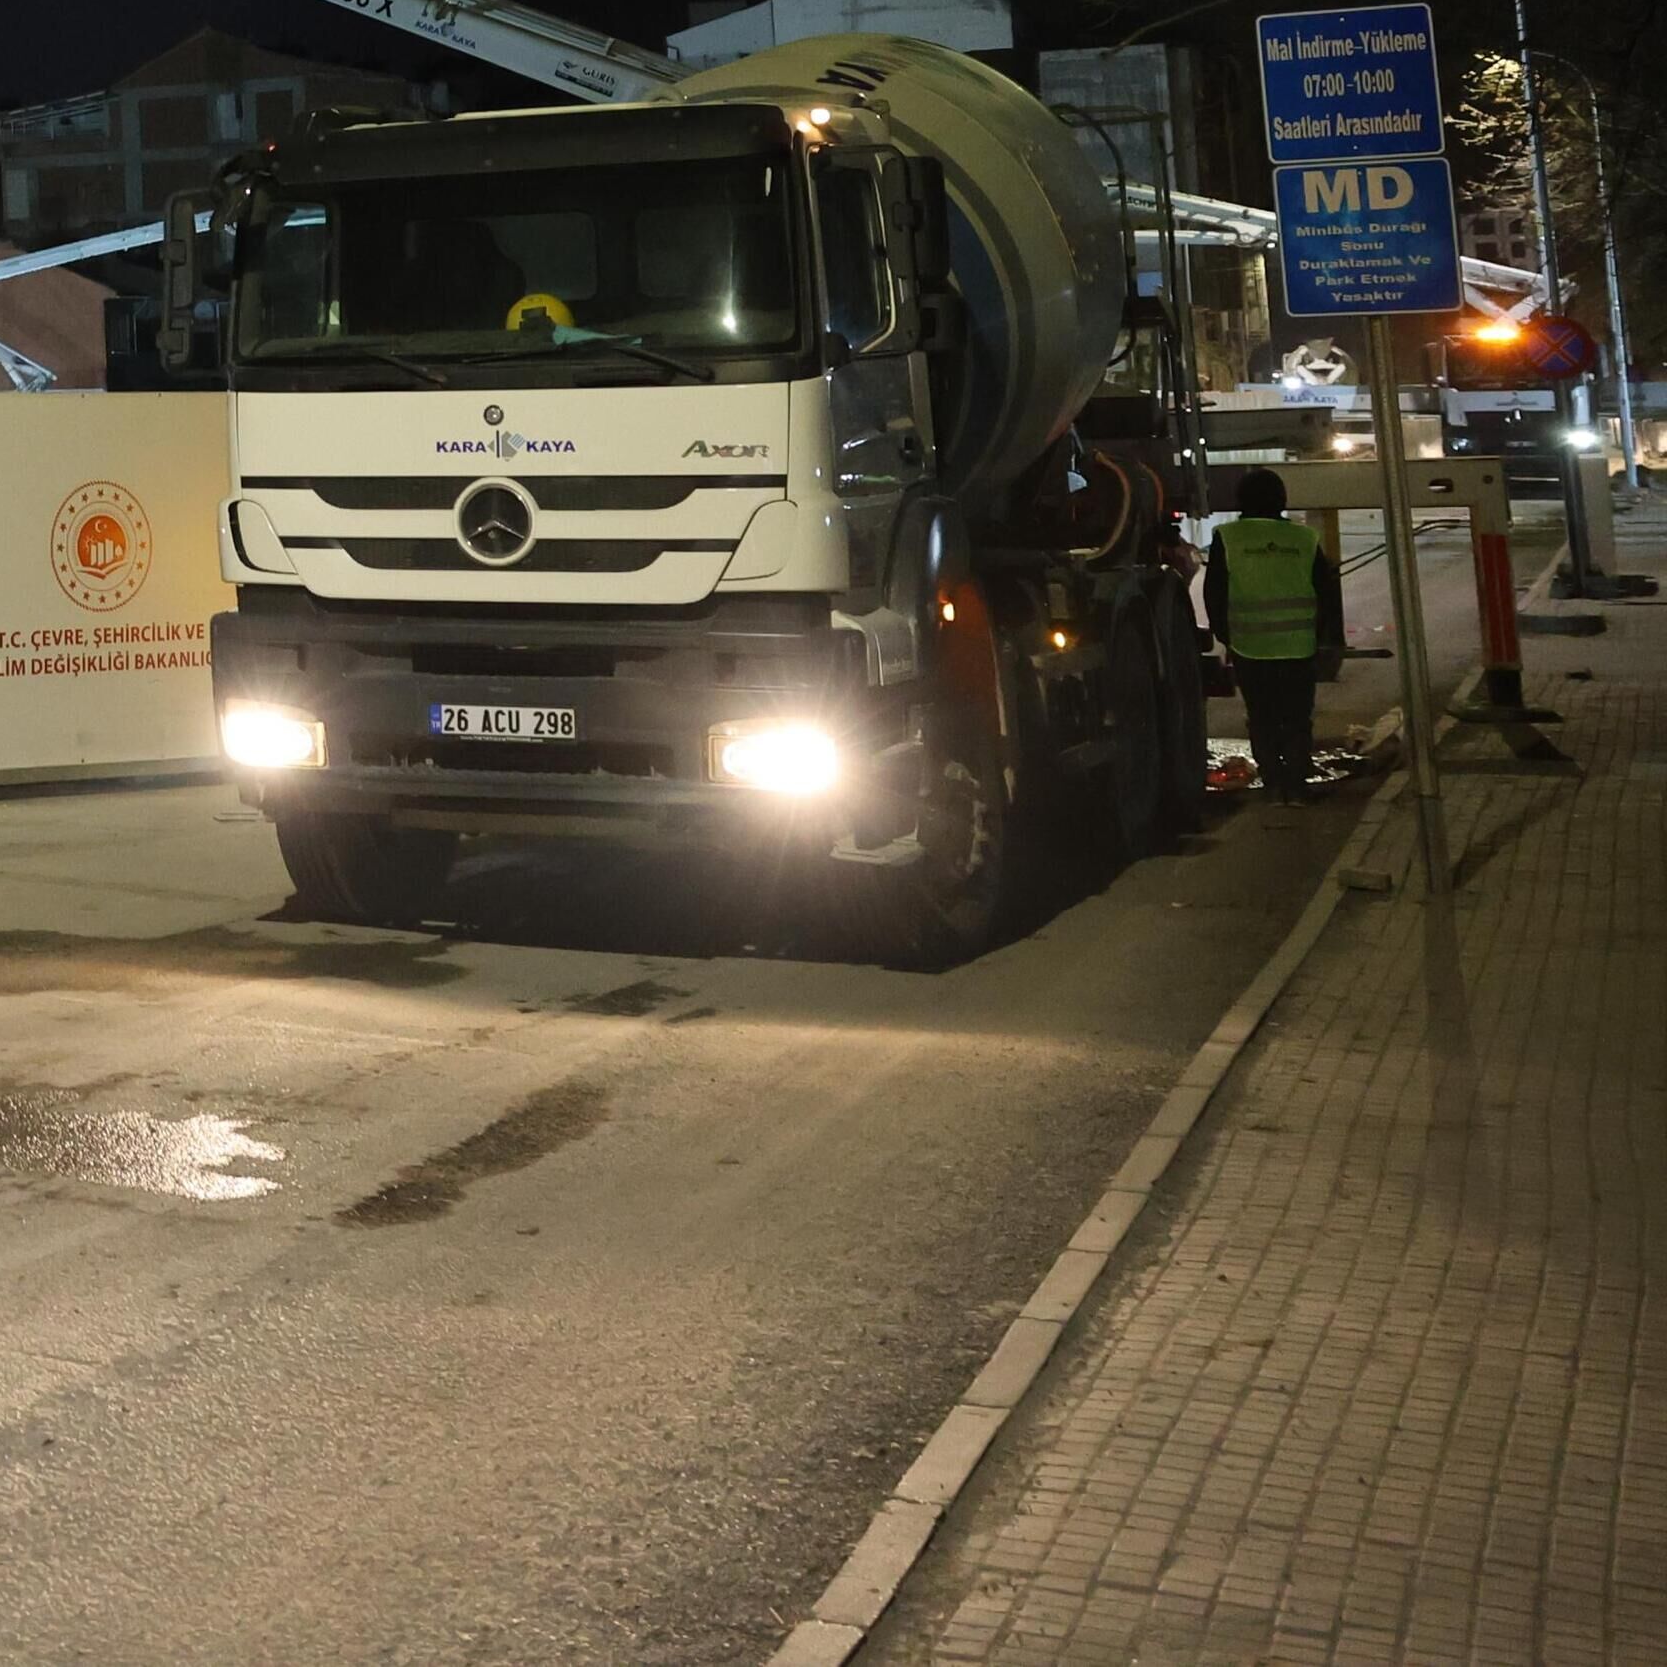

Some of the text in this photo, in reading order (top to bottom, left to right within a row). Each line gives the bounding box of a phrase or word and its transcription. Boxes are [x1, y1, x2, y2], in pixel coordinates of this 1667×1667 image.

[1267, 37, 1293, 61] Mal
[1273, 108, 1422, 141] Saatleri Arasındadır
[1303, 166, 1414, 214] MD
[1341, 241, 1385, 252] Sonu
[1299, 255, 1432, 271] Duraklamak Ve
[1315, 273, 1417, 287] Park Etmek
[1331, 291, 1405, 304] Yasaktır
[436, 440, 576, 454] KARA KAYA
[31, 629, 89, 652] ÇEVRE,
[93, 621, 182, 649] ŞEHİRCİLİK
[185, 623, 205, 640] VE
[31, 650, 130, 676] DEĞİŞİKLİĞİ
[443, 708, 573, 735] 26 ACU 298
